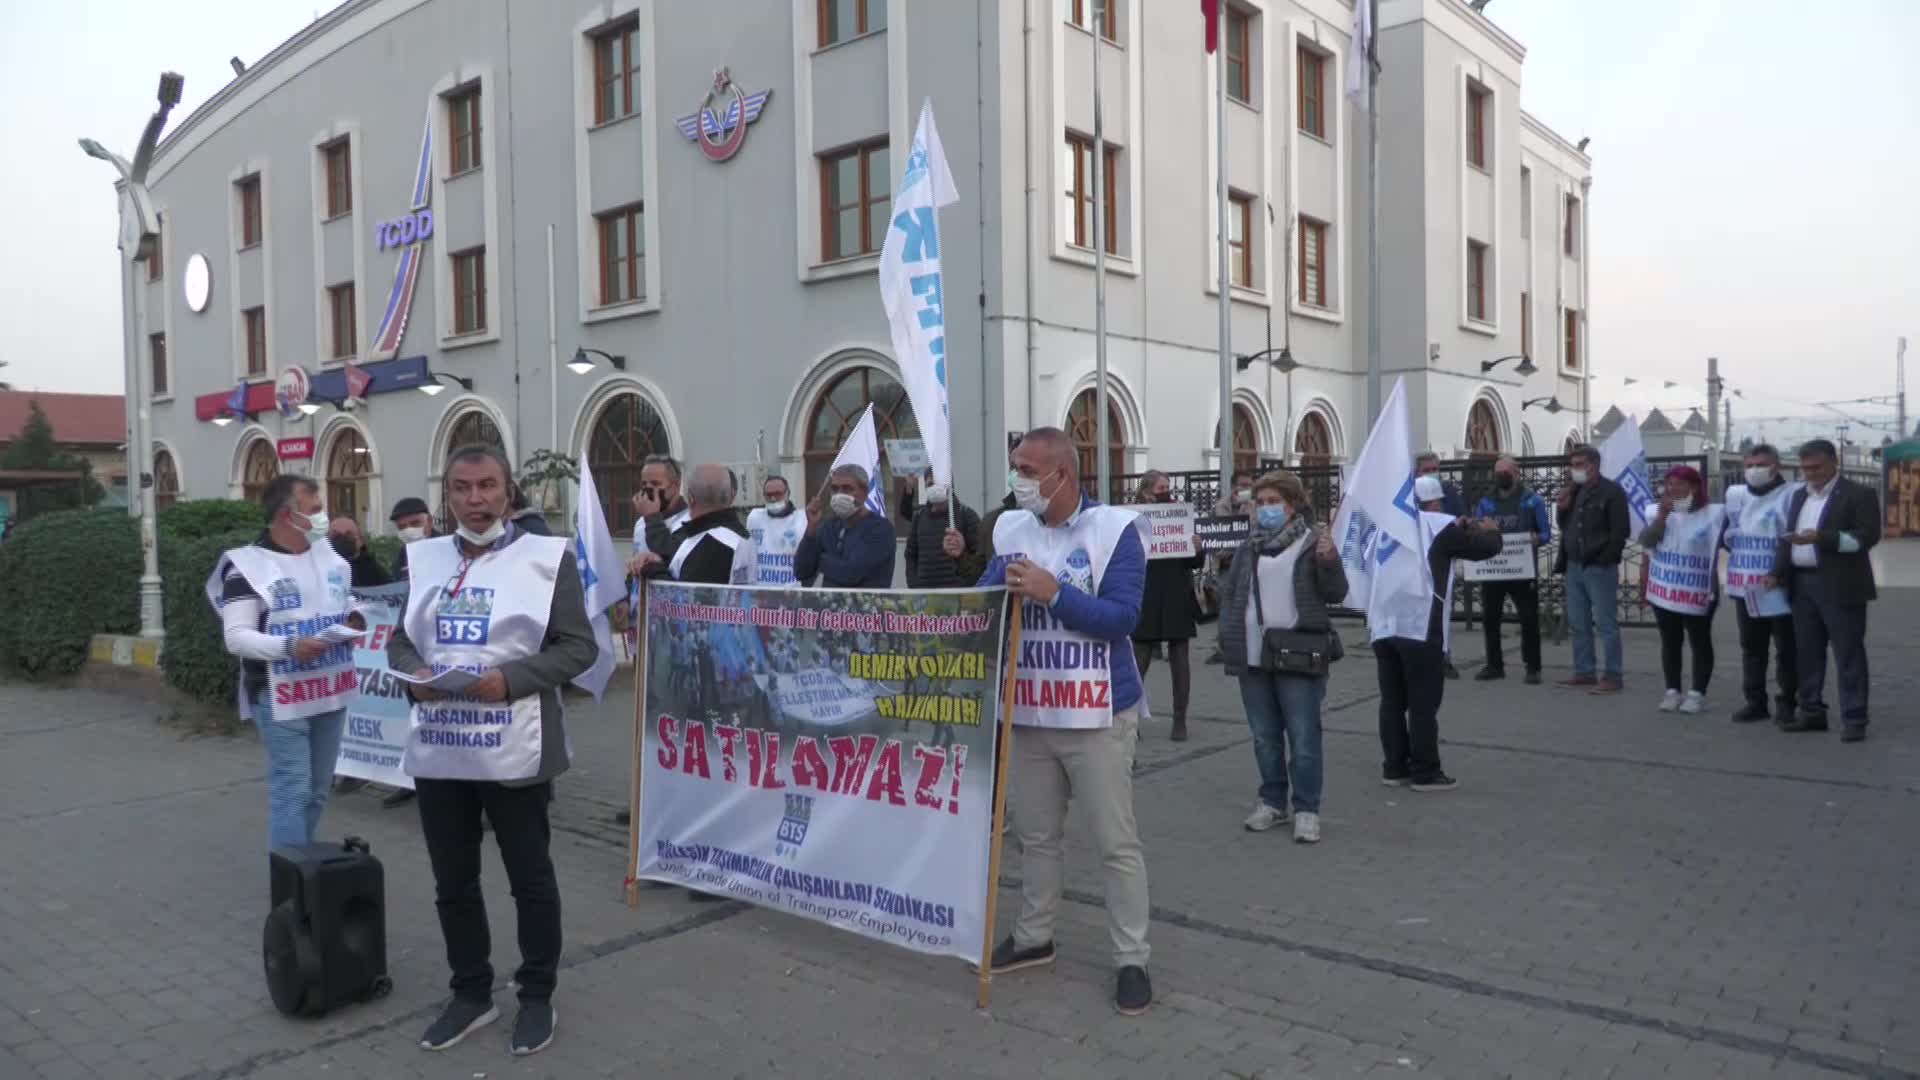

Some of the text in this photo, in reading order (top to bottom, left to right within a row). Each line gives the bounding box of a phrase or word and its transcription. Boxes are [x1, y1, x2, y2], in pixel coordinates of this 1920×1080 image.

[376, 210, 433, 253] TCDD
[1232, 521, 1249, 532] Bizi
[439, 618, 483, 642] BTS
[797, 608, 820, 630] Bir
[821, 608, 883, 633] Gelecek
[348, 716, 384, 741] KESK
[420, 730, 501, 748] SENDİKASI
[657, 712, 968, 816] SATILAMAZ!
[778, 820, 808, 844] BTS
[773, 866, 873, 905] ÇALIŞANLARI
[695, 867, 728, 887] Trade
[728, 879, 762, 899] Union
[767, 891, 781, 903] of
[858, 911, 952, 946] Employees
